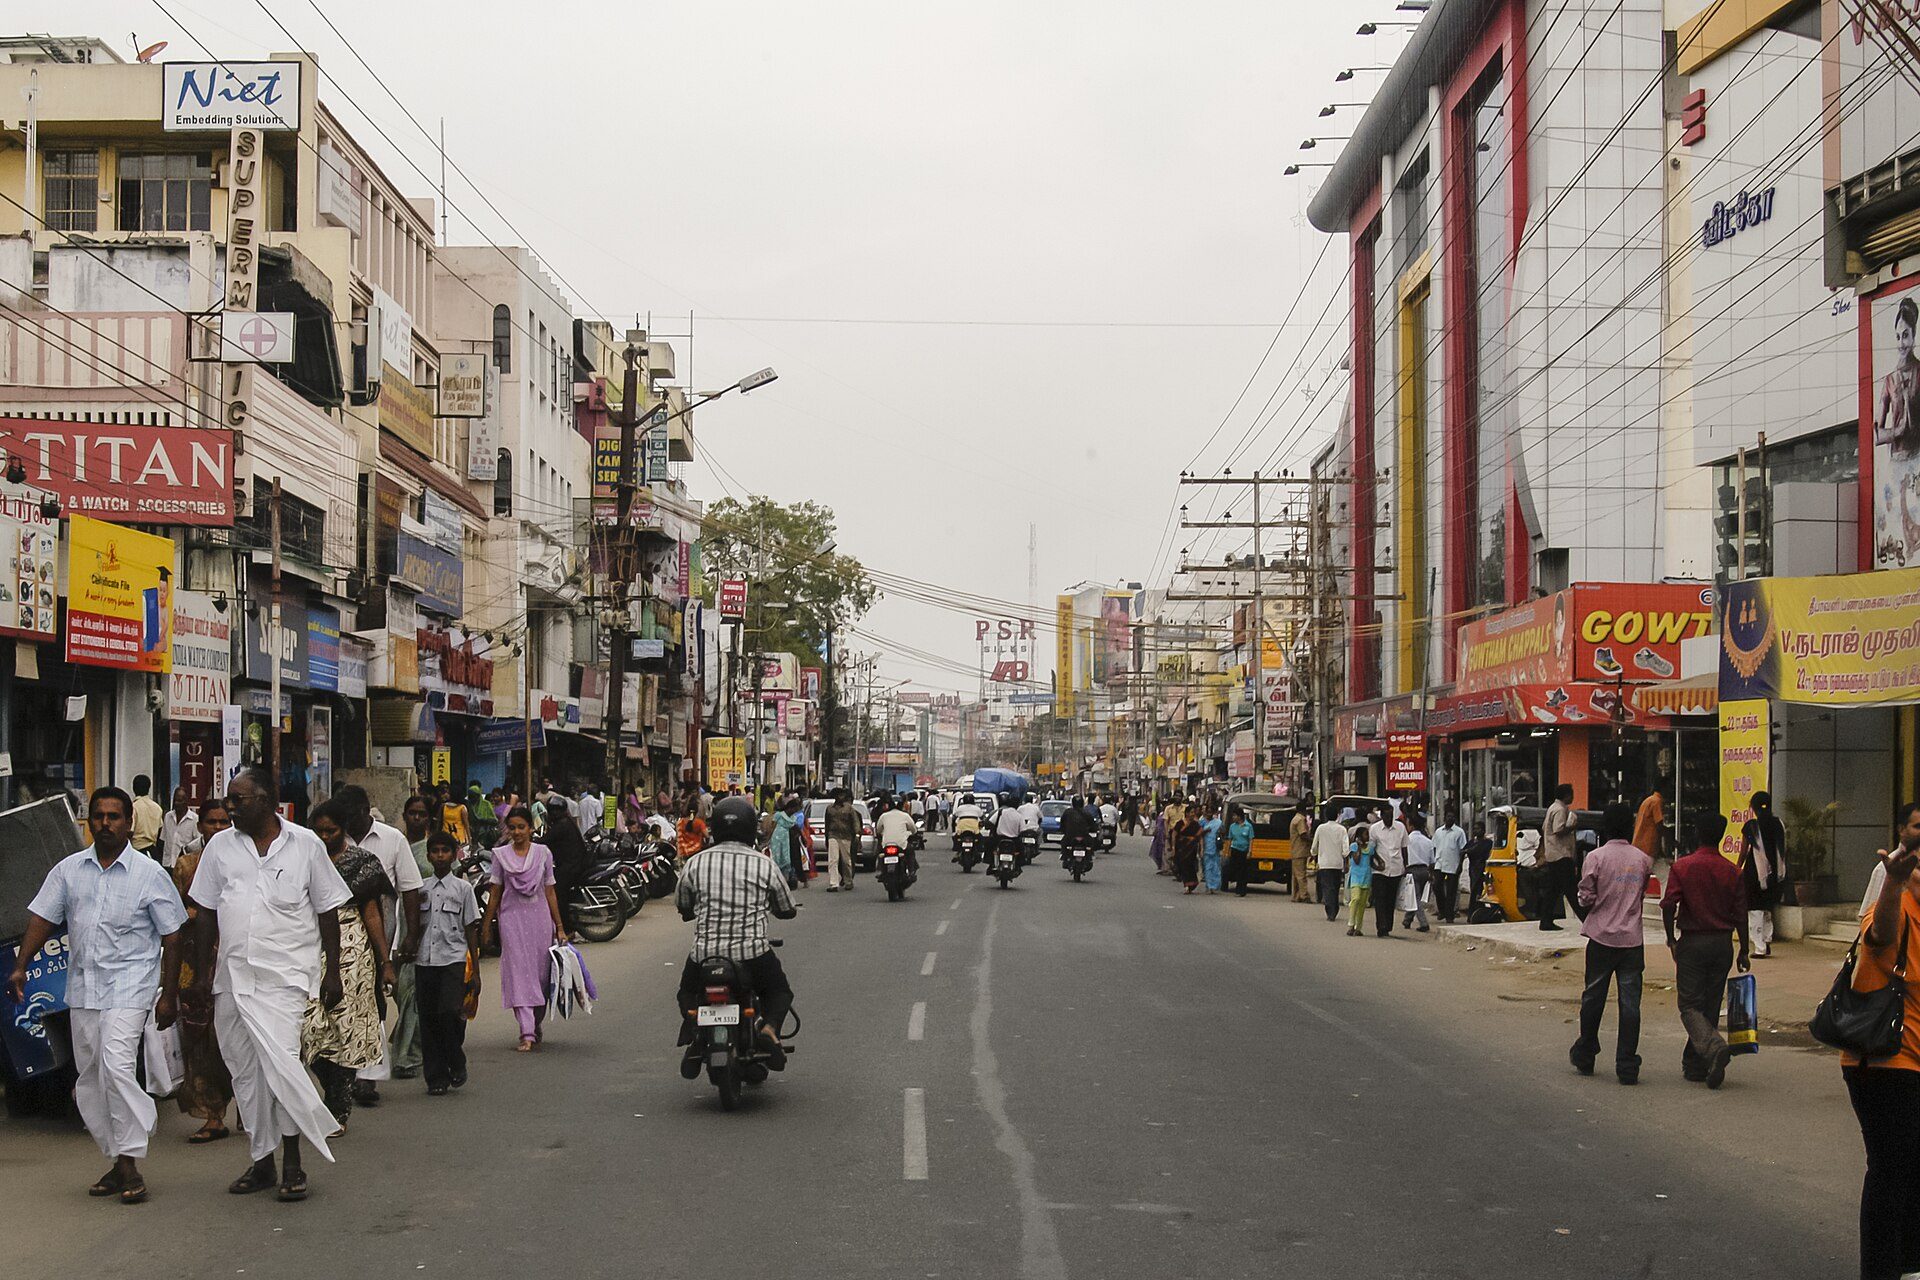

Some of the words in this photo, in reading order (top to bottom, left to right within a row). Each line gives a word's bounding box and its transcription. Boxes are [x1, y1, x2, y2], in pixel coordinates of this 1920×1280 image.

[177, 67, 282, 110] Niet
[176, 115, 232, 126] Embedding
[236, 115, 283, 124] Solutions
[23, 433, 227, 489] TITAN
[82, 496, 129, 511] WATCH
[137, 499, 226, 515] ACCESSORIES
[260, 606, 297, 661] Suer
[984, 645, 1027, 653] SILKS
[1469, 639, 1507, 671] GOWTHAM
[1508, 623, 1552, 660] CHAPPALS
[186, 674, 227, 704] TITAN
[711, 758, 732, 767] BUY
[736, 758, 743, 767] 2
[1399, 762, 1414, 770] CAR
[1390, 772, 1423, 780] PARKING
